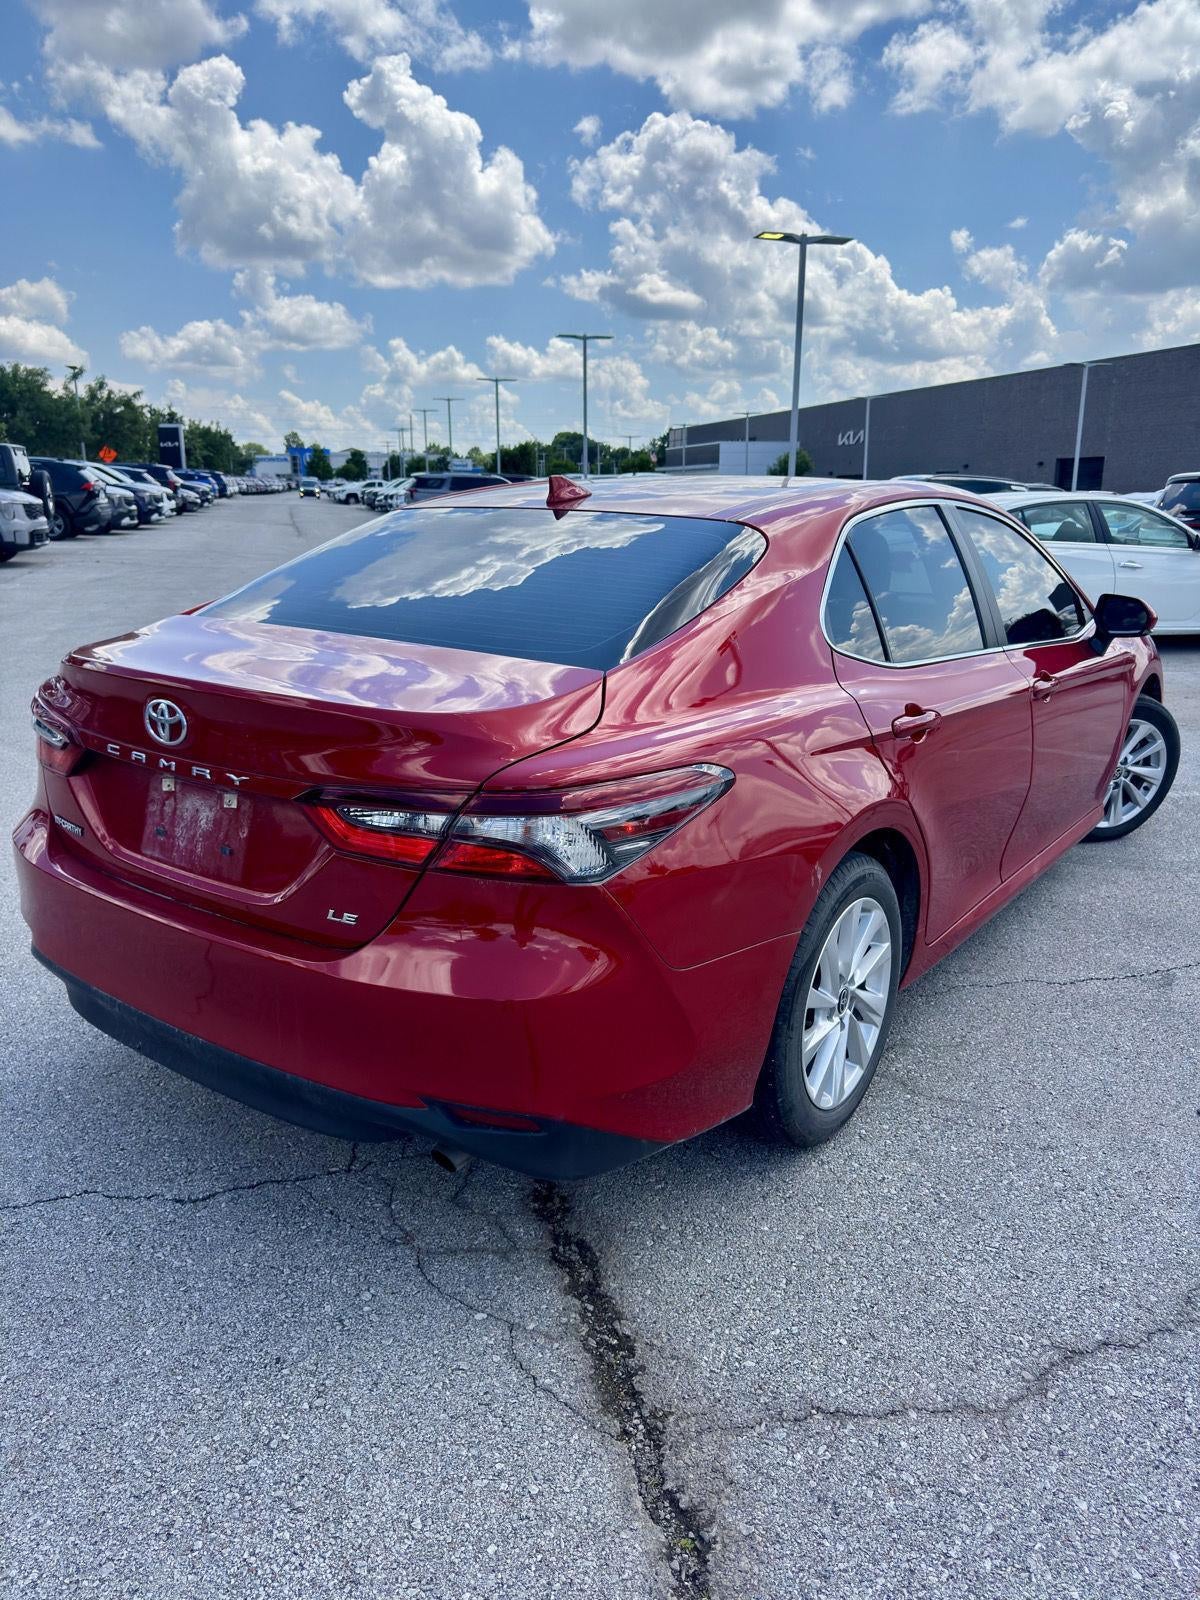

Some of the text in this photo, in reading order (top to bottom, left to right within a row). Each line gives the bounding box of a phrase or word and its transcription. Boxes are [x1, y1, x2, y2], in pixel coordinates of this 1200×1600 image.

[838, 430, 864, 446] KIA
[107, 743, 250, 786] CAMRY
[326, 909, 359, 926] LE
